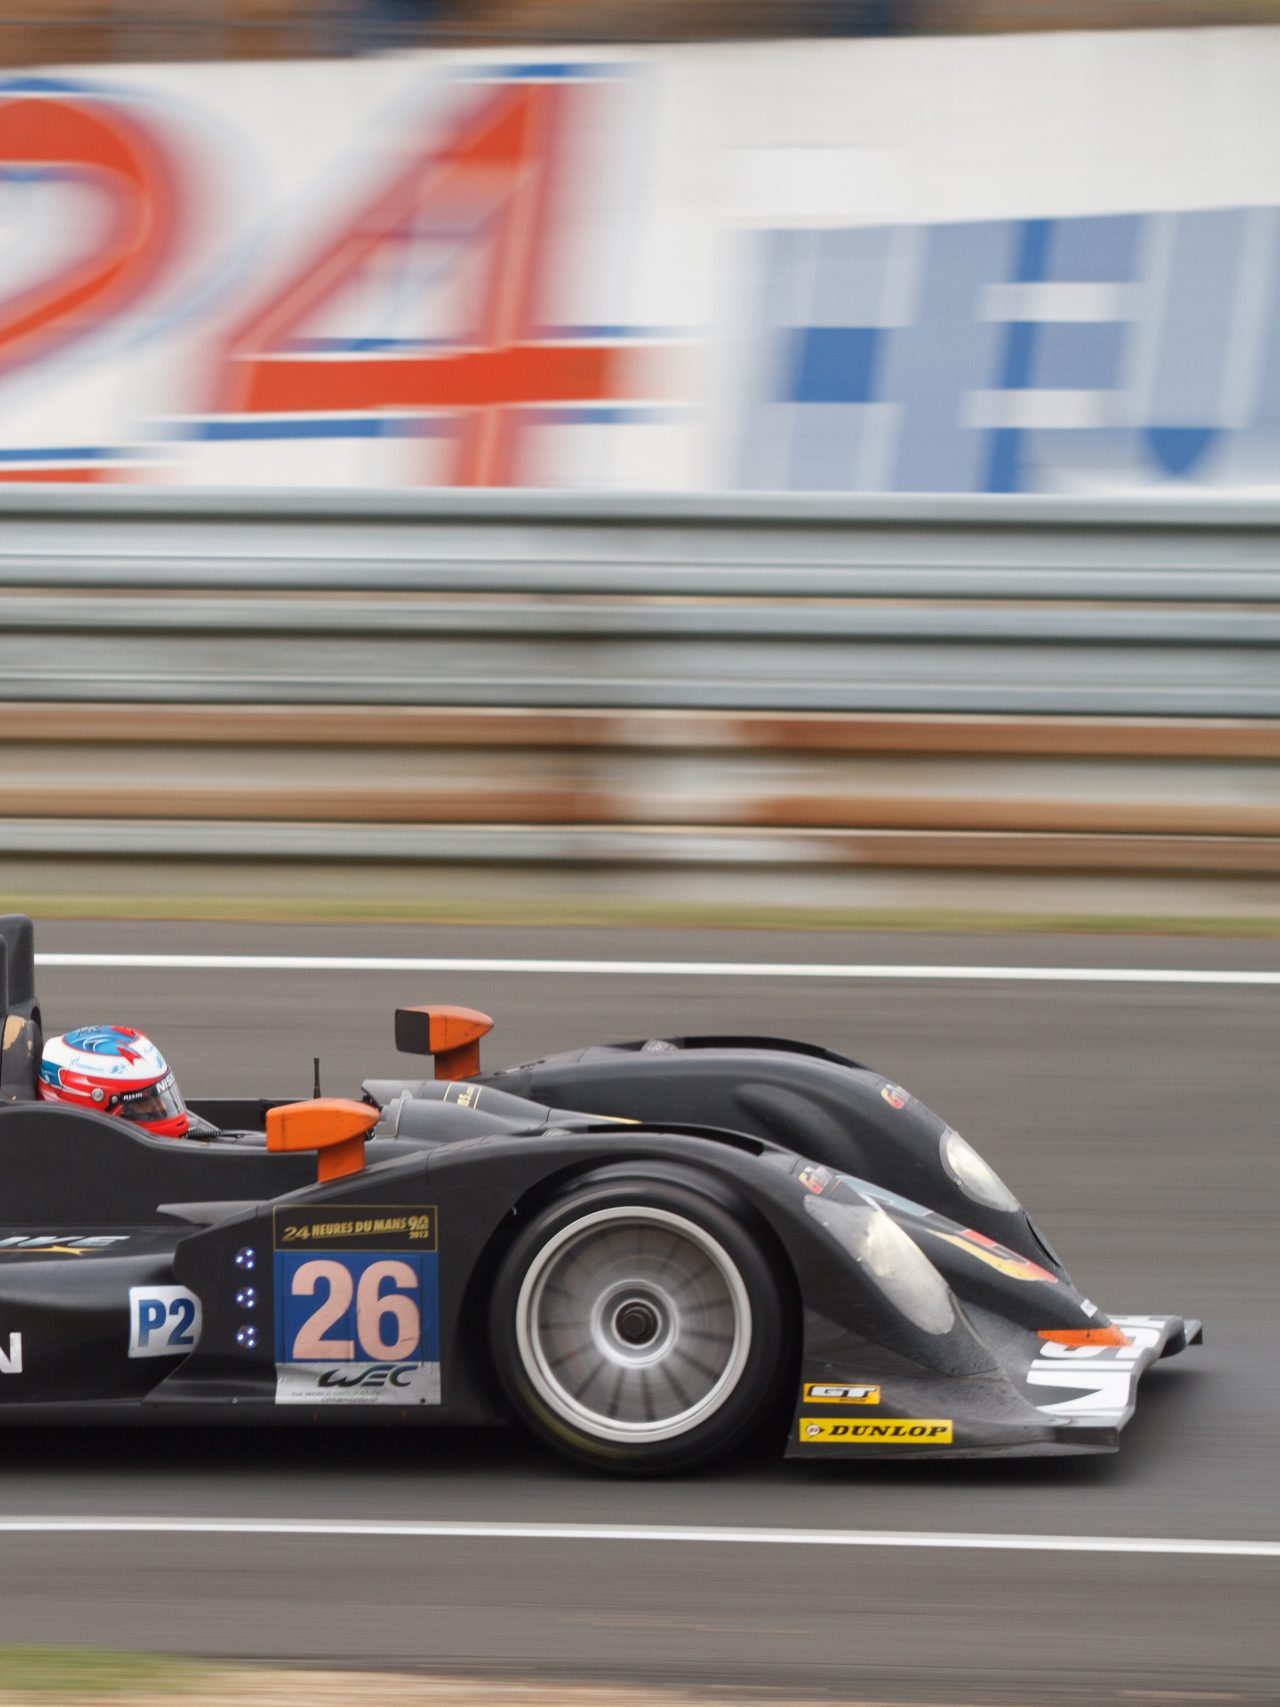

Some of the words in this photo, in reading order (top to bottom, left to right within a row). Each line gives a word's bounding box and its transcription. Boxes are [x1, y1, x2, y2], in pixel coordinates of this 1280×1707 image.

[281, 1225, 311, 1242] 24
[312, 1221, 354, 1238] HEURES
[355, 1219, 373, 1233] DU
[373, 1217, 407, 1232] MANS
[138, 1298, 195, 1347] P2
[292, 1260, 420, 1360] 26
[318, 1364, 418, 1388] WEC
[828, 1425, 948, 1437] DUNLOP
